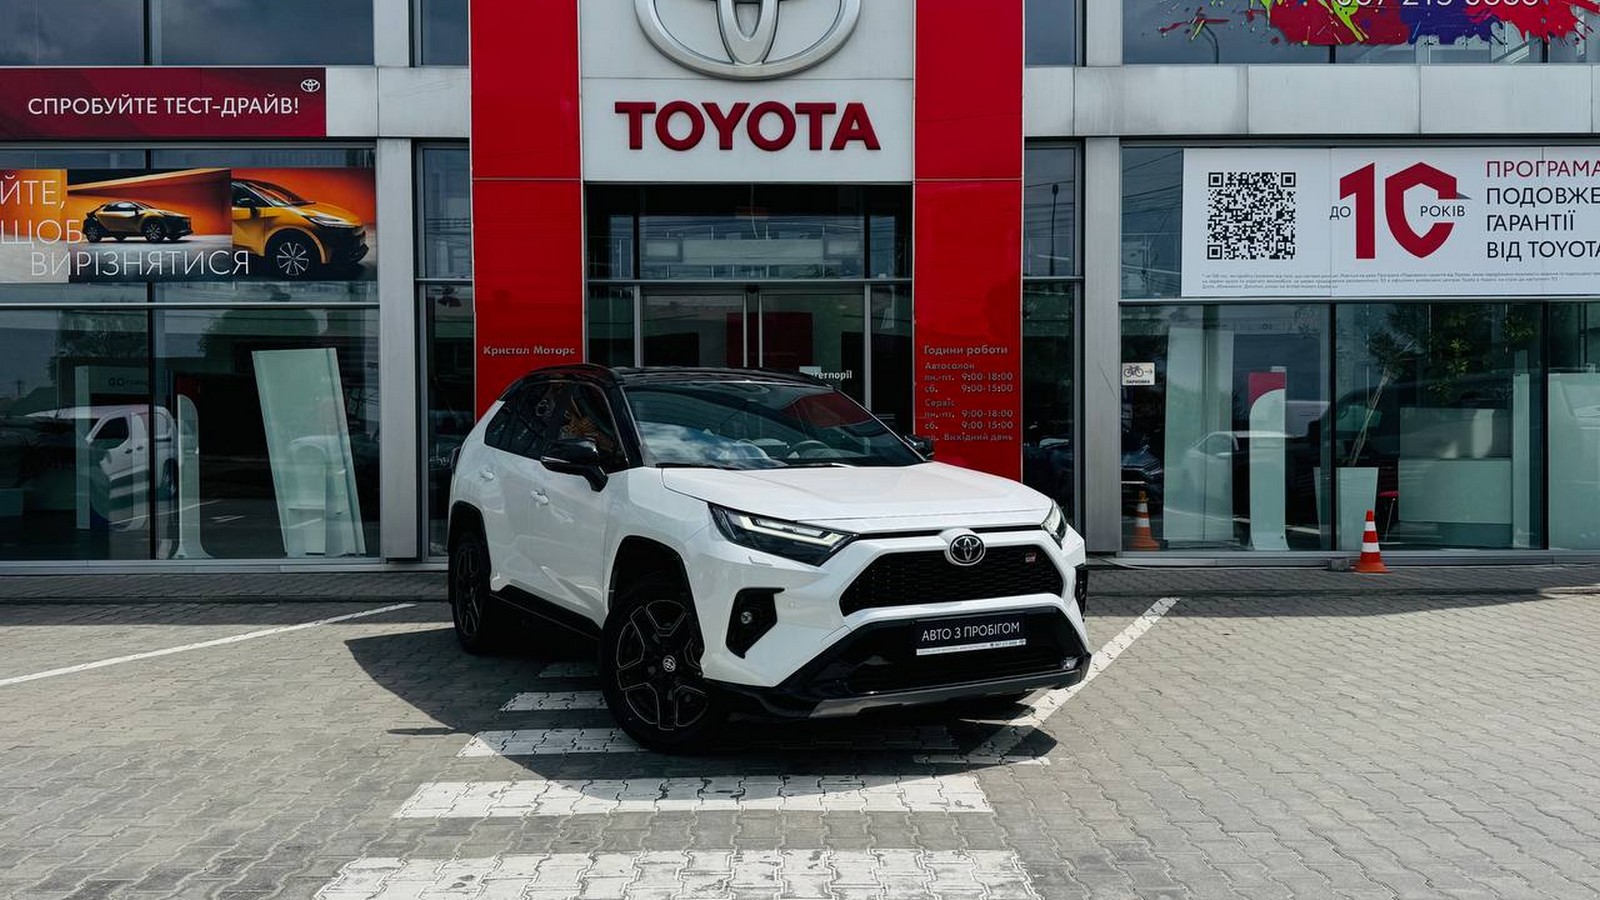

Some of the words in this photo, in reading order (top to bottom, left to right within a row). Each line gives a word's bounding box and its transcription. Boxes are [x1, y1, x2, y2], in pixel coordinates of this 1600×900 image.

[28, 94, 158, 115] СПРОБУЙТЕ
[163, 94, 299, 118] ТЕСТ-ДРАЙВ!
[615, 101, 882, 152] TOYOTA
[1486, 160, 1600, 178] ПРОГРАМА
[0, 174, 65, 209] ЙТЕ,
[1486, 187, 1600, 208] ПОДОВЖЕ
[1329, 205, 1352, 221] ДО
[1420, 205, 1466, 218] РОКІВ
[1486, 210, 1576, 231] ГАРАНТІЇ
[0, 219, 83, 249] ЩОБ
[1487, 242, 1522, 262] ВІД
[30, 250, 250, 277] ВИРІЗНЯТИСЯ
[483, 346, 530, 356] Кристал
[533, 345, 575, 356] Моторс
[924, 345, 964, 356] Години
[966, 344, 1008, 356] роботи
[925, 362, 975, 370] Автосалон
[921, 628, 952, 642] АВТО
[954, 626, 961, 639] З
[964, 621, 1020, 638] ПРОБІГОМ
